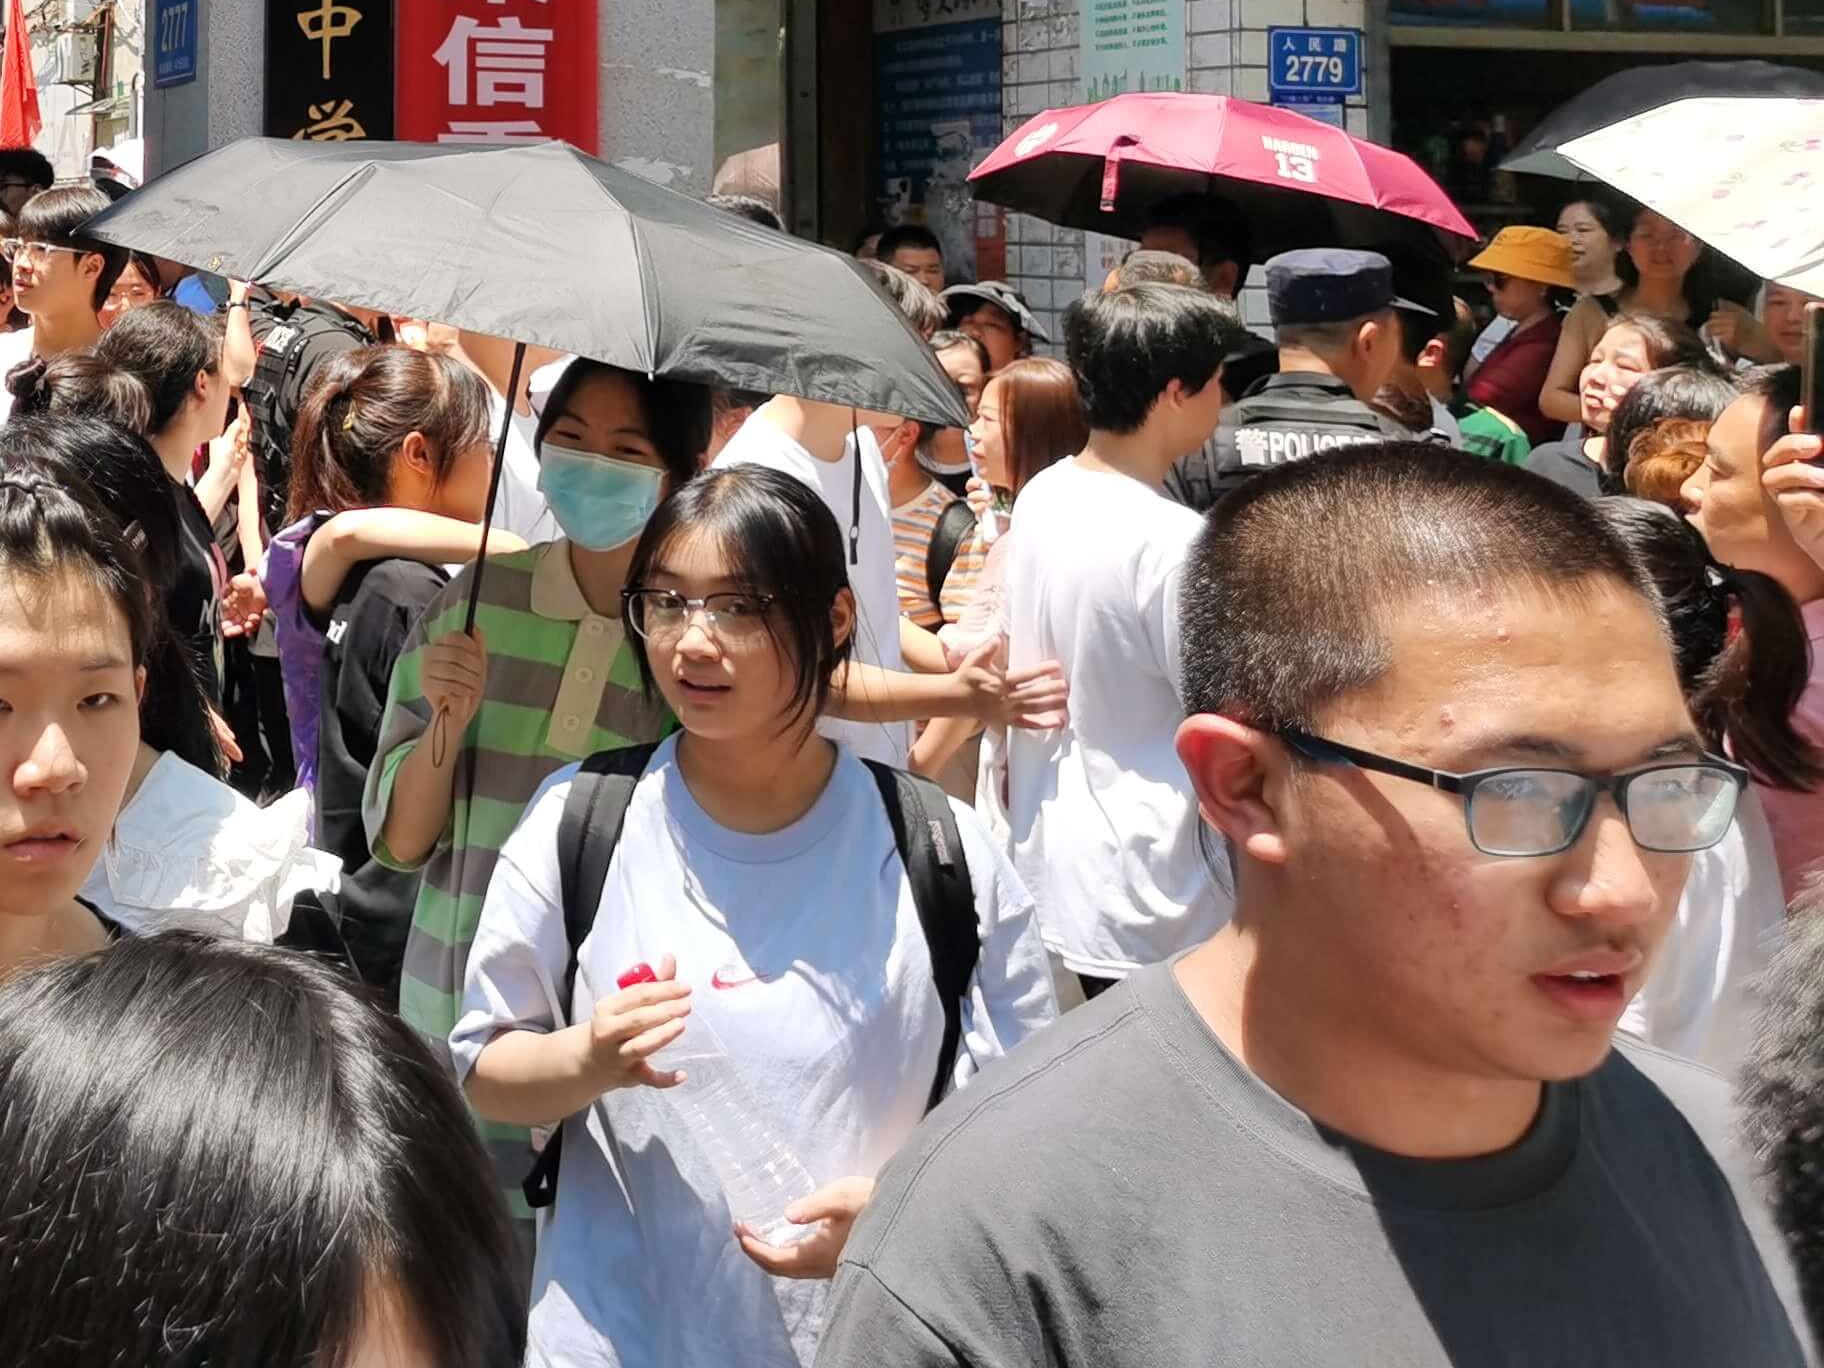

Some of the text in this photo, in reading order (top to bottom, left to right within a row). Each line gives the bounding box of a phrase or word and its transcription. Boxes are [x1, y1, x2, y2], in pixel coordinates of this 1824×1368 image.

[161, 1, 188, 52] 2777
[1285, 55, 1344, 84] 2779
[1275, 152, 1315, 183] 13
